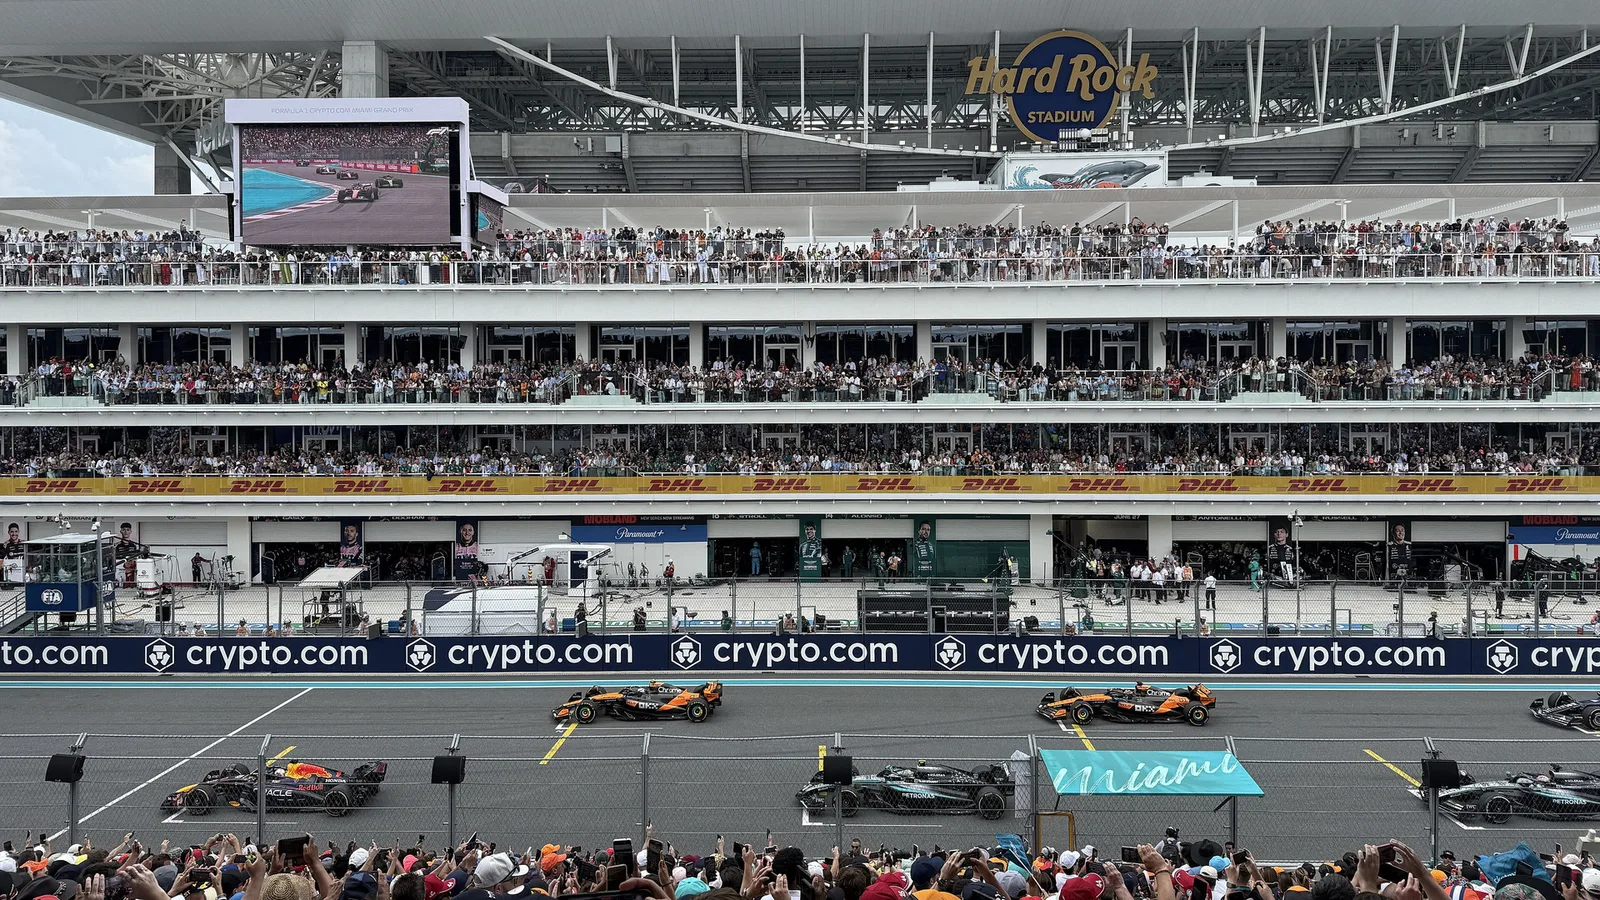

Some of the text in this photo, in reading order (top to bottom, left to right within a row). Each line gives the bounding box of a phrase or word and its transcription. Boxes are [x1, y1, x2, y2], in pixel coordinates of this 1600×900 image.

[964, 53, 1158, 101] Hard Rock
[1027, 110, 1095, 123] STADIUM
[27, 480, 82, 493] DHL
[128, 480, 185, 493] DHL
[229, 480, 287, 493] DHL
[333, 480, 391, 492] DHL
[439, 480, 499, 492] DHL
[544, 480, 603, 492] DHL
[649, 479, 709, 492] DHL
[753, 479, 812, 491] DHL
[856, 478, 917, 491] DHL
[961, 478, 1022, 491] DHL
[1068, 478, 1130, 491] DHL
[1178, 479, 1241, 491] DHL
[1287, 479, 1350, 492] DHL
[1396, 479, 1459, 492] DHL
[1505, 479, 1569, 492] DHL
[584, 515, 637, 524] MOBLAND
[1523, 515, 1579, 525] MOBLAND
[614, 526, 664, 540] Paramount+
[1, 641, 108, 665] to.com
[186, 641, 369, 670] crypto.com
[448, 639, 633, 669] crypto.com
[713, 639, 898, 668] crypto.com
[978, 640, 1169, 669] crypto.com
[1254, 641, 1446, 671] crypto.com
[1053, 753, 1240, 796] Miami
